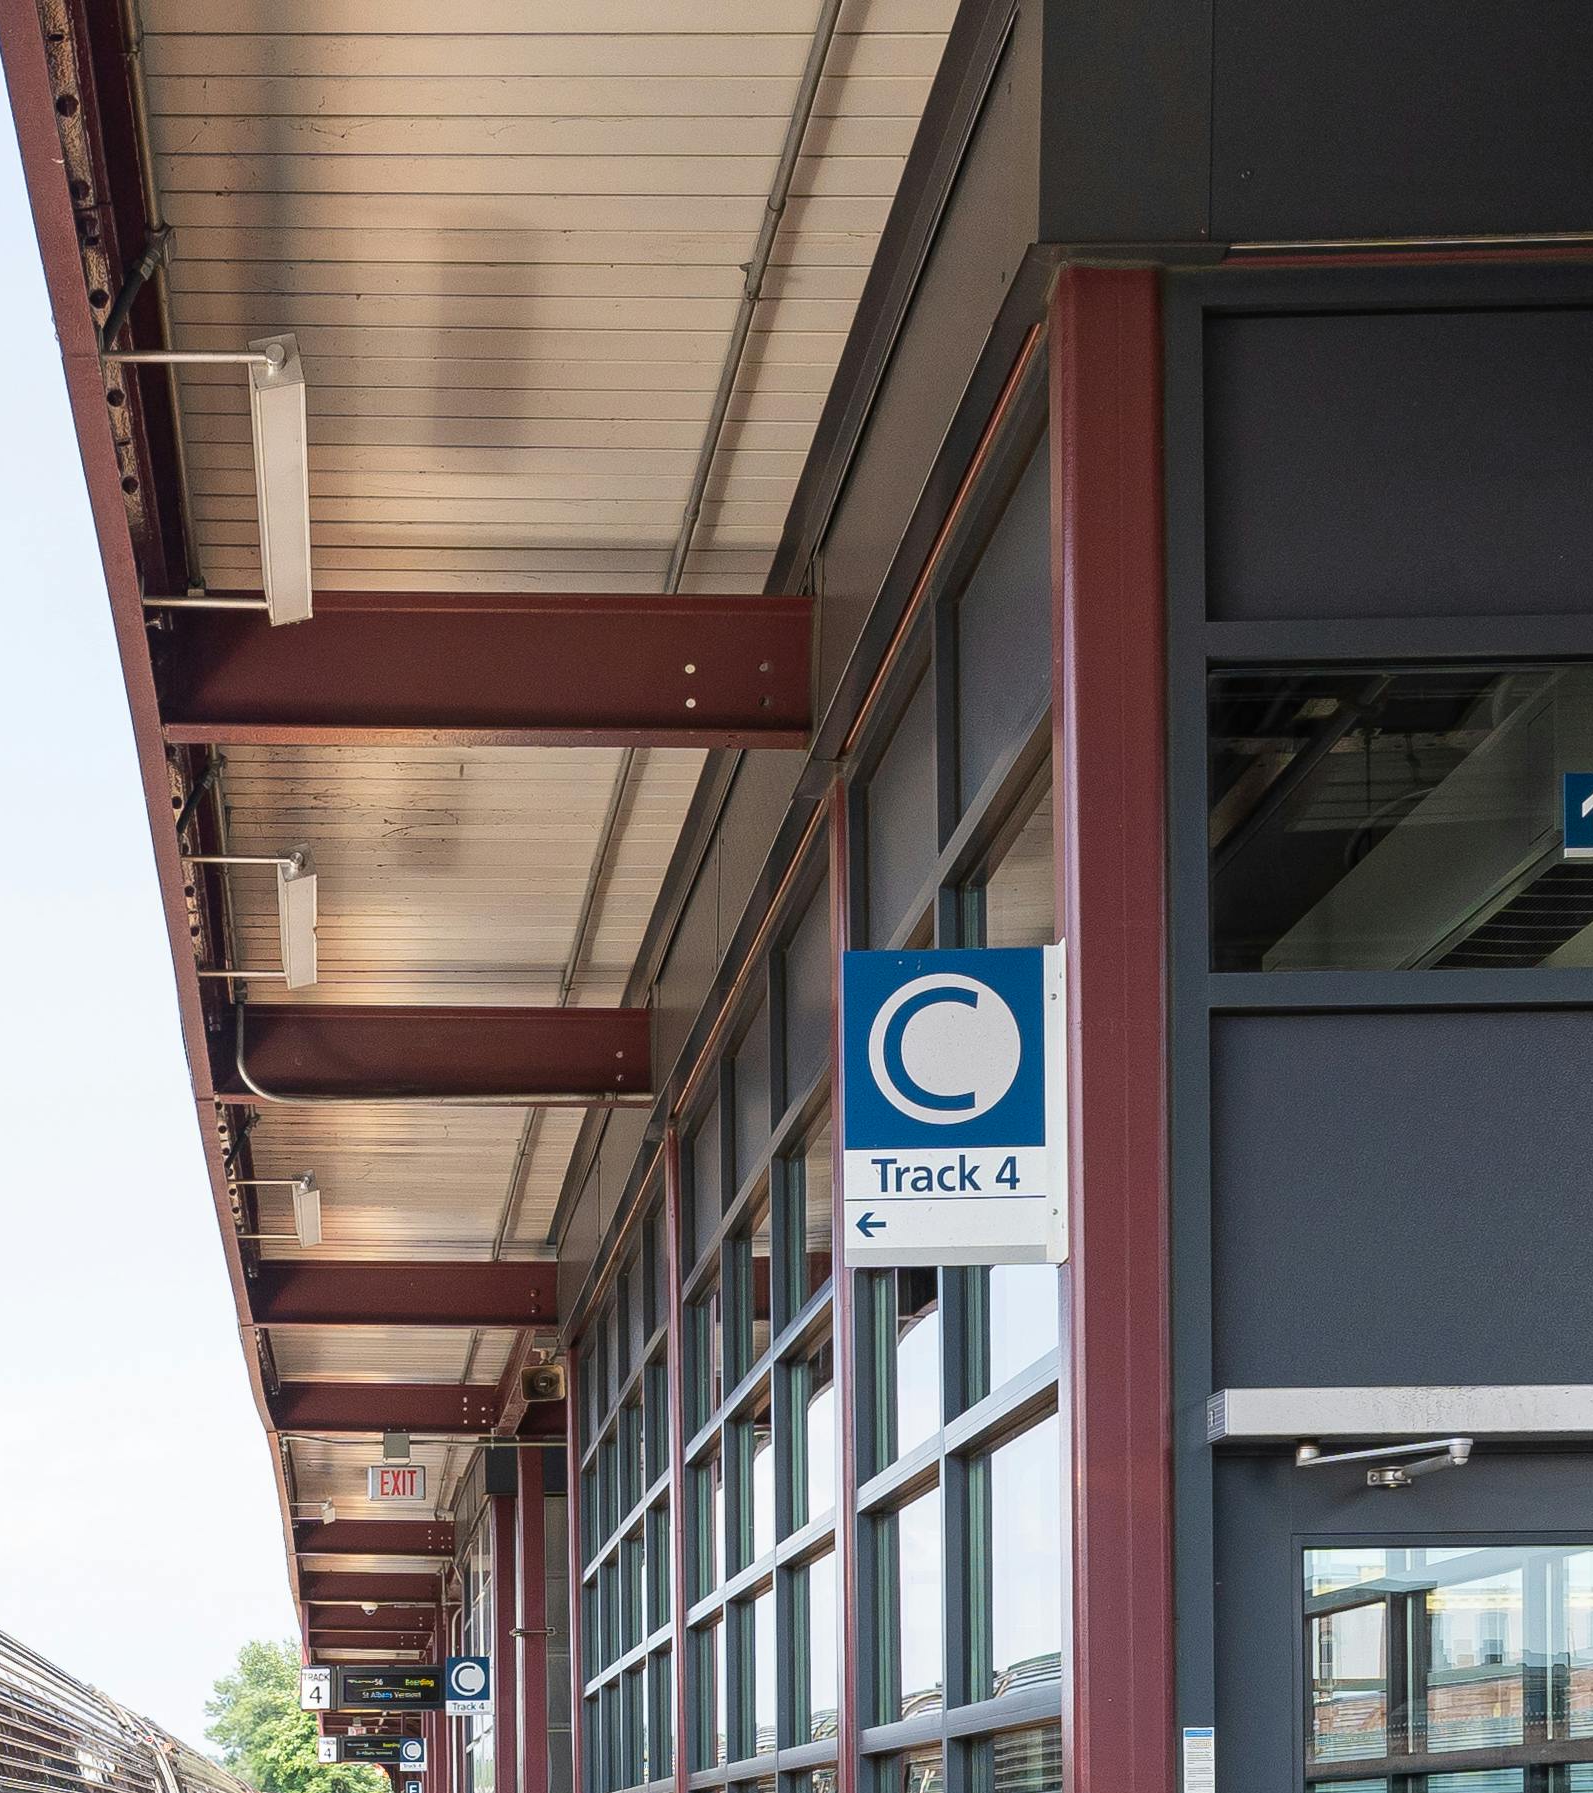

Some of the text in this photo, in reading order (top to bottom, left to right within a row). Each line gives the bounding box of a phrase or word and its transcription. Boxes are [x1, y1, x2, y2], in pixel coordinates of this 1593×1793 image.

[883, 986, 979, 1111] C
[871, 1154, 1020, 1193] Track 4
[380, 1470, 417, 1496] EXIT
[302, 1673, 330, 1681] TRACK
[454, 1665, 476, 1693] C
[309, 1686, 323, 1704] 4
[452, 1702, 485, 1711] Track 4
[324, 1748, 331, 1759] 4
